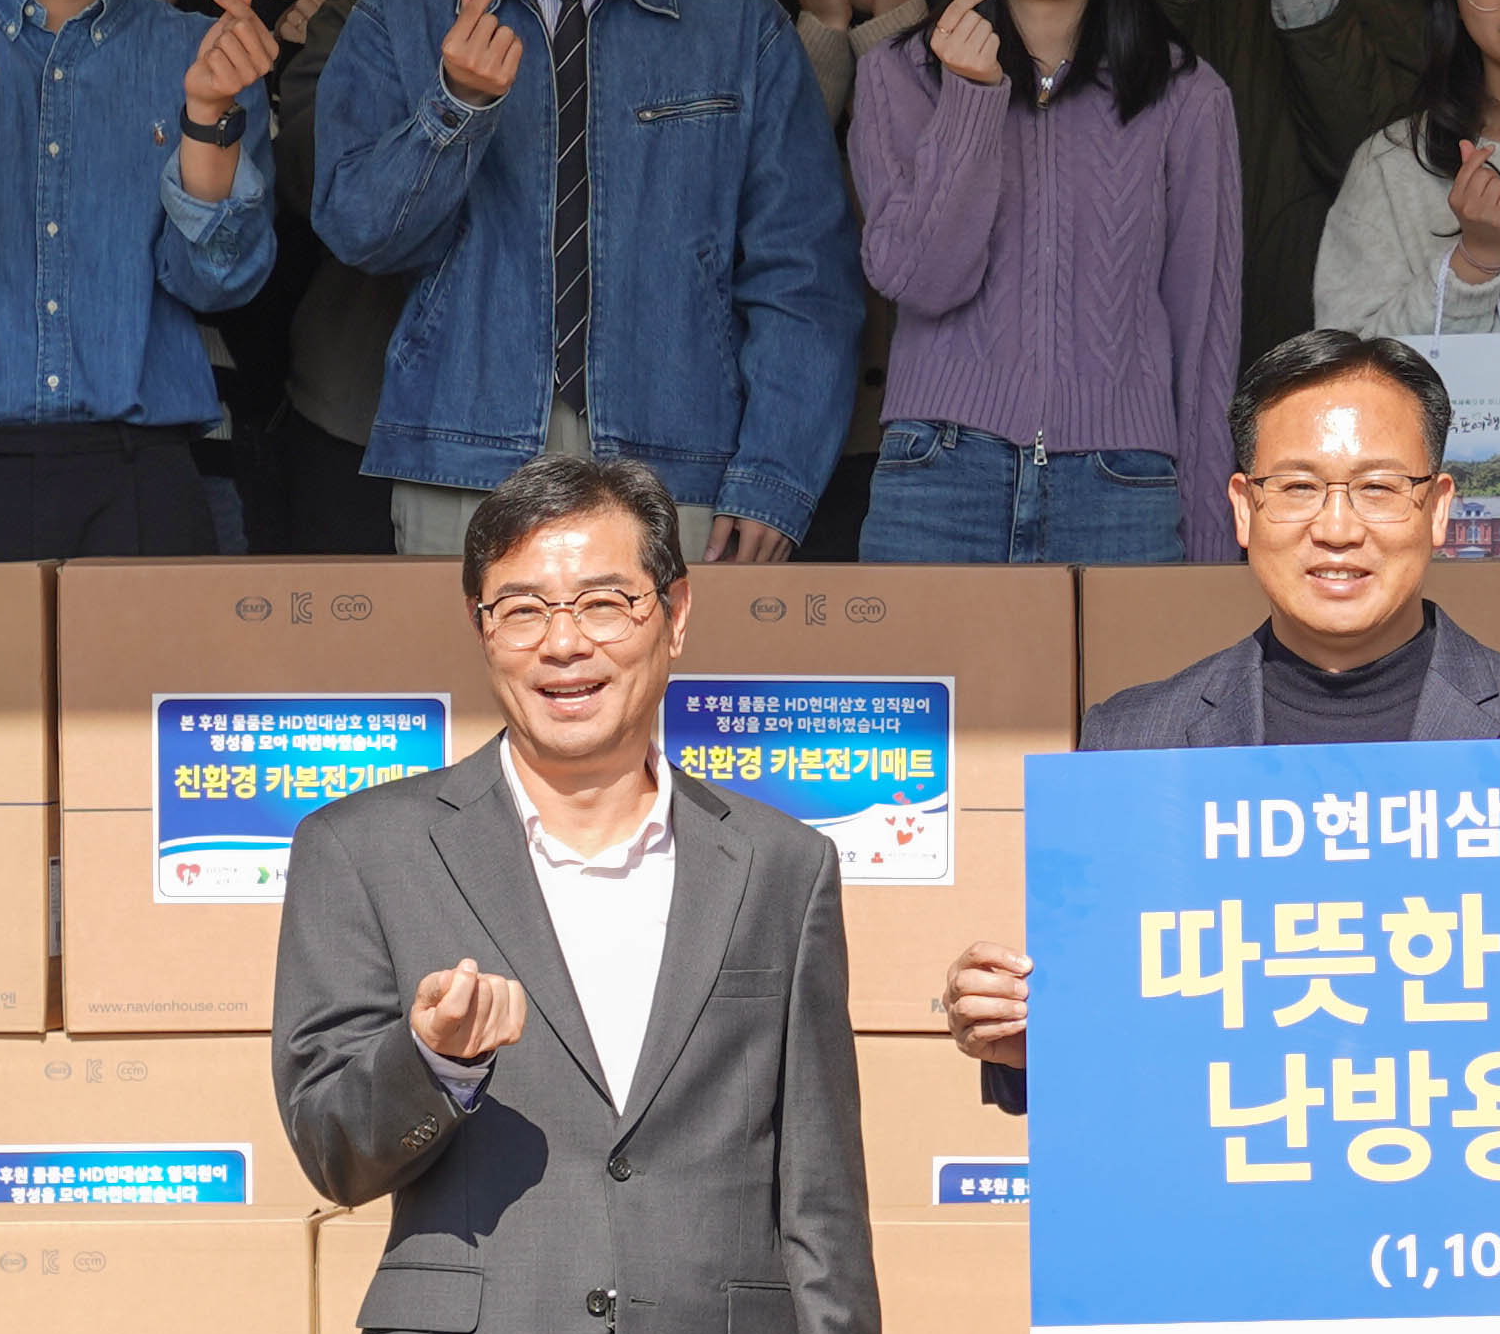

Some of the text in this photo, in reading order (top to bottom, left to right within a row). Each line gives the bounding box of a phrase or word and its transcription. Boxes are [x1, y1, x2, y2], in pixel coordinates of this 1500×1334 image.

[1451, 412, 1500, 433] 포여행
[684, 697, 929, 714] 본 후원 물품은 HD현대삼호 임직원이
[179, 714, 425, 731] 본 후원 물품은 HD현대삼호 임직원이
[715, 717, 900, 734] 정성을 모아 마련하였습니다
[210, 735, 396, 751] 정성을 모아 마련하였습니다
[679, 747, 934, 781] 친환경 카본전기매트
[175, 765, 256, 799] 친환경
[88, 1000, 249, 1014] www.navienhouse.com
